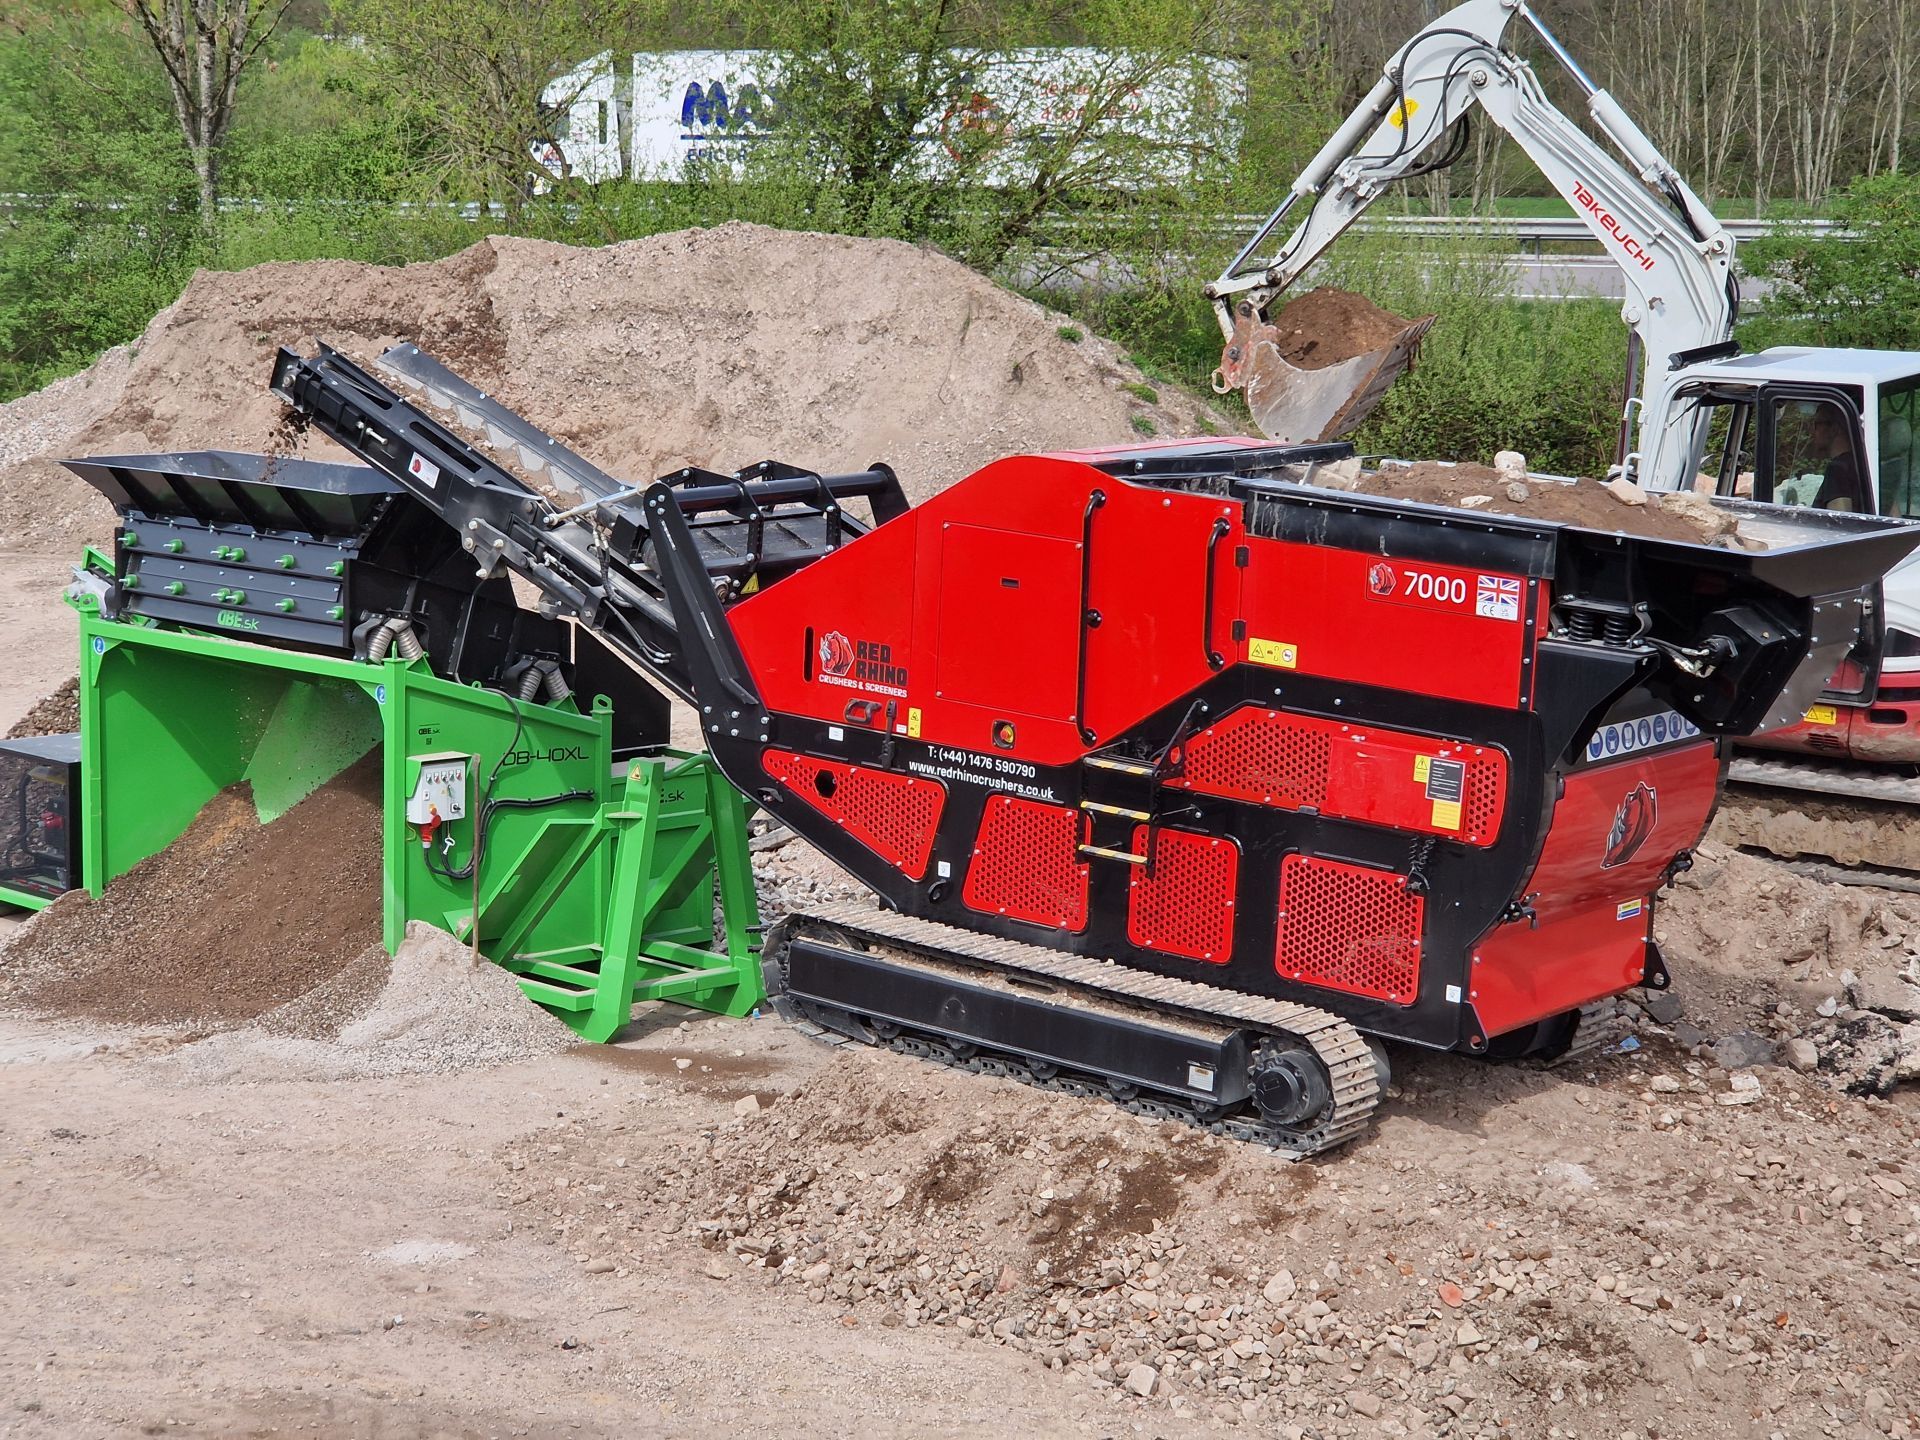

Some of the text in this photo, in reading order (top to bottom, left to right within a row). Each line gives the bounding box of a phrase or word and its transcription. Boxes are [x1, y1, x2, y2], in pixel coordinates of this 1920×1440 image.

[1404, 571, 1466, 604] 7000
[856, 640, 891, 664] RED
[818, 674, 908, 699] CRUSHERS & SCREENERS
[855, 660, 908, 688] RHINO
[927, 745, 1036, 779] T: (+44) 1476 590790
[908, 760, 1055, 800] www.redrhinocrushers.co.uk
